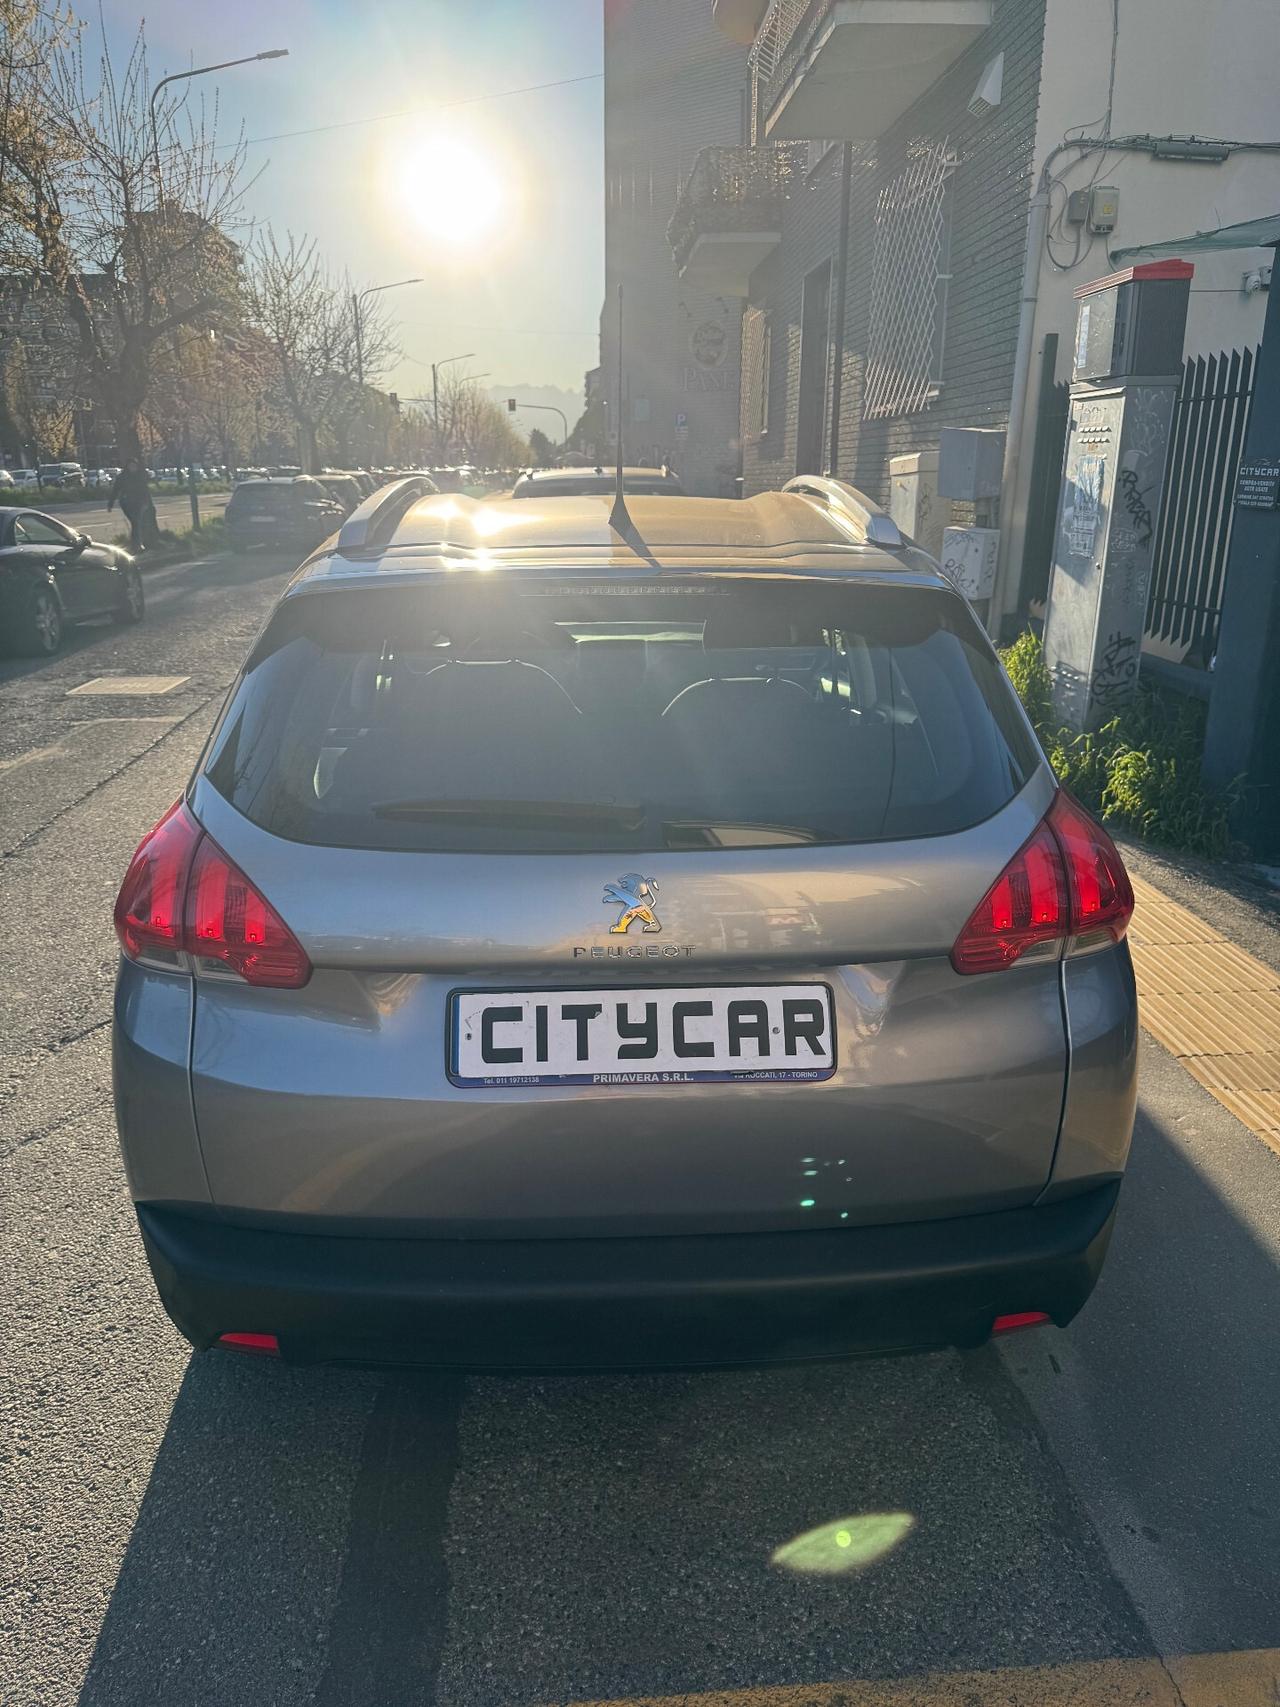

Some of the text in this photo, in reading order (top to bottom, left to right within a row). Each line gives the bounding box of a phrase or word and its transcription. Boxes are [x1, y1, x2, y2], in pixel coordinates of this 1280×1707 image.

[1240, 467, 1280, 477] CITYCAR
[573, 945, 697, 958] PEUGEOT
[481, 999, 827, 1063] CITYCAR
[593, 1073, 694, 1083] PRIMAVERA S.R.L.
